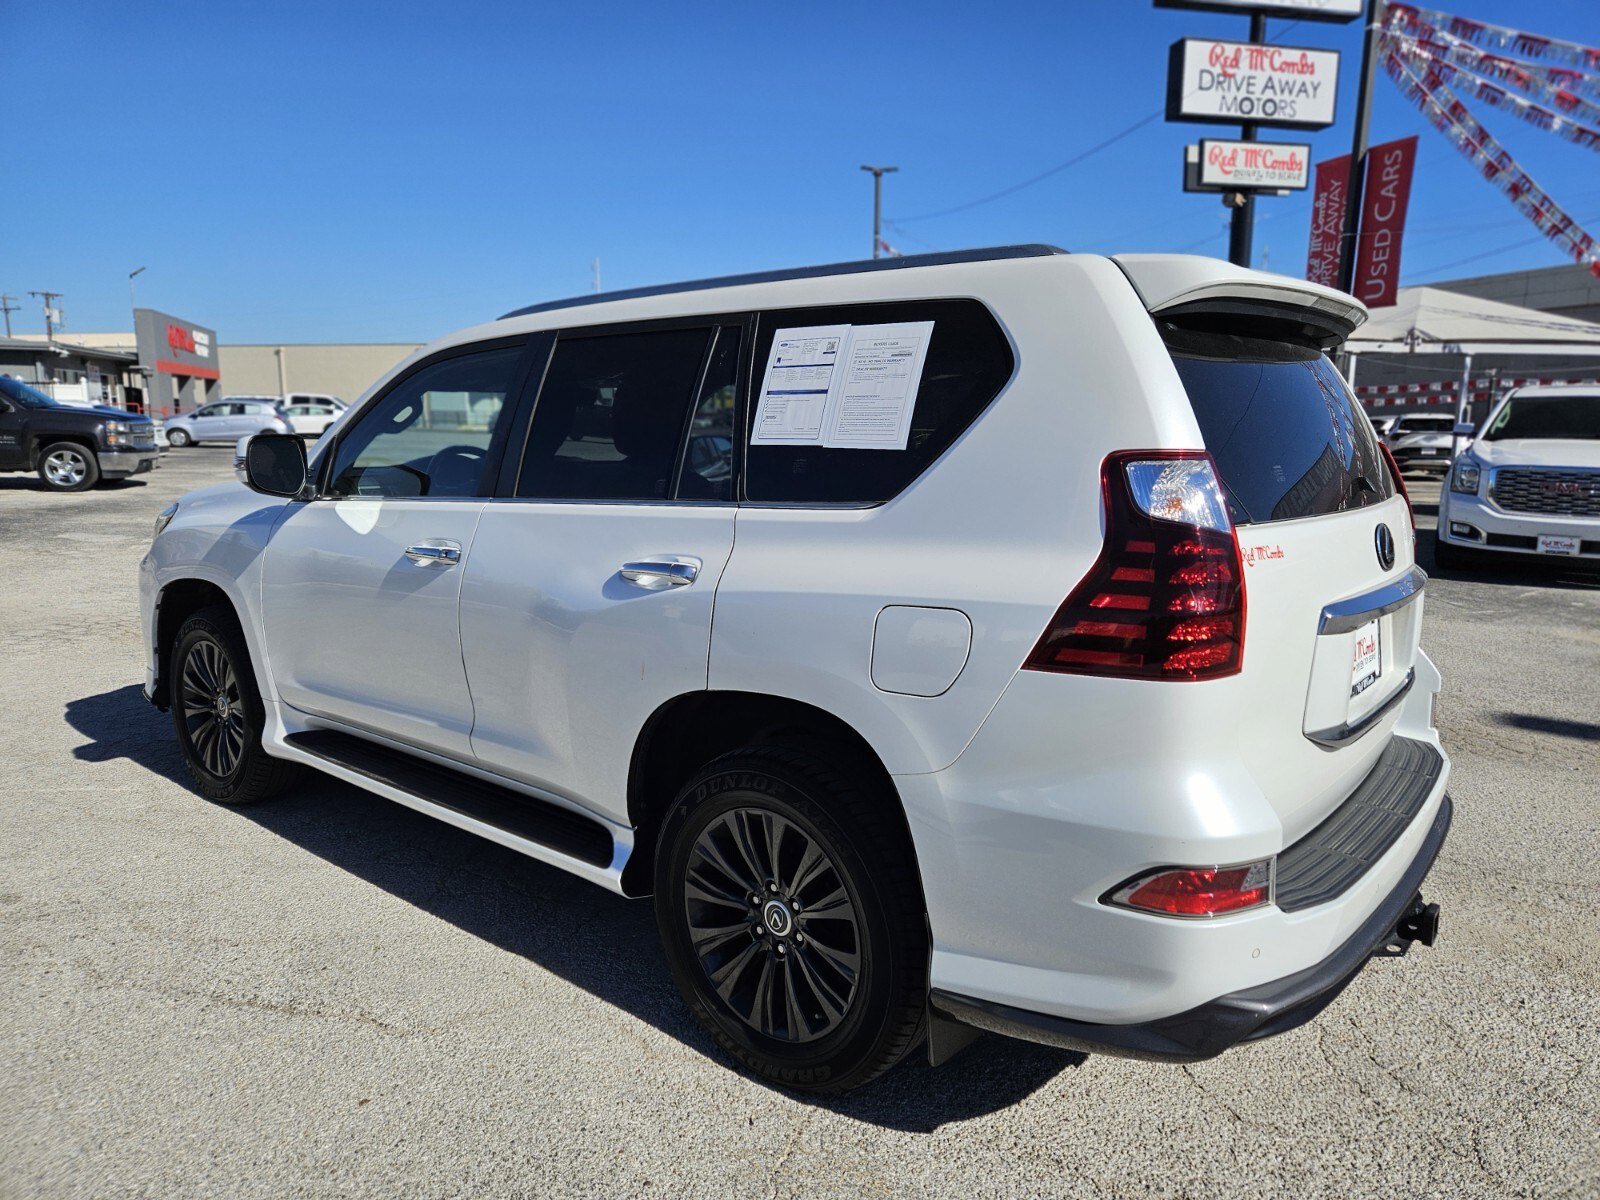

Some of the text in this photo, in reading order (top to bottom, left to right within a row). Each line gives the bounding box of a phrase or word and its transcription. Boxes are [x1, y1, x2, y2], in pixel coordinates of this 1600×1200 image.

[1209, 43, 1315, 77] Red McCombs
[1198, 69, 1321, 99] DRIVE AWAY
[1218, 96, 1297, 118] MOTORS
[1208, 144, 1303, 175] Red McCombs
[1325, 179, 1342, 234] AWAY
[1309, 192, 1328, 254] McCombs
[1362, 149, 1402, 300] USED CARS
[1241, 545, 1285, 567] Red McCombs
[695, 774, 787, 804] DUNLOP
